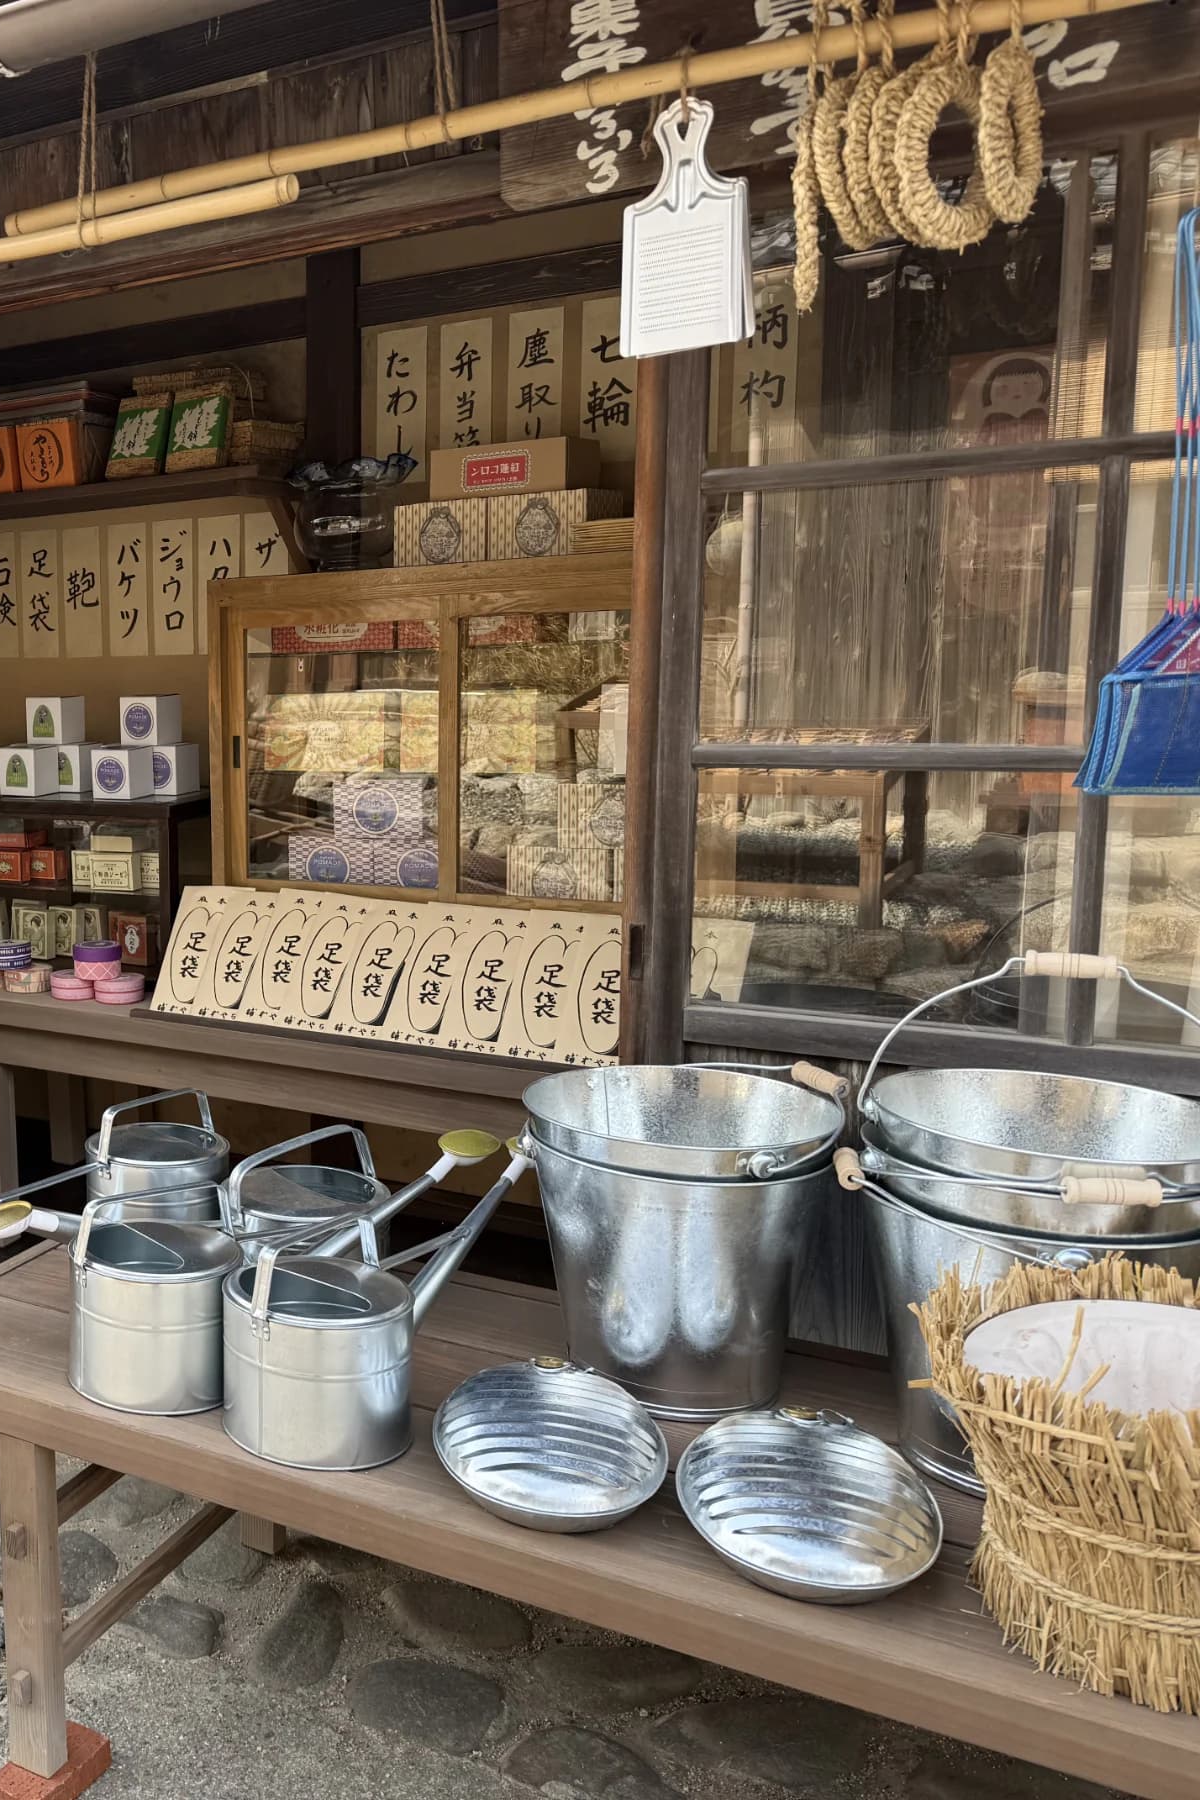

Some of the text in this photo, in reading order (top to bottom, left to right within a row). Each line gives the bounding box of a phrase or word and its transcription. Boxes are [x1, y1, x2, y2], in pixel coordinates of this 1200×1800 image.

[515, 327, 560, 440] 塵取り
[582, 334, 633, 434] 七輪
[27, 549, 56, 632] 足袋
[65, 567, 100, 611] 鞄
[117, 538, 142, 639] バケツ
[159, 529, 188, 631] ジョウロ
[178, 931, 209, 979] 足袋
[223, 935, 253, 984] 足袋
[271, 935, 303, 984] 足袋
[311, 942, 344, 993] 足袋
[360, 947, 395, 998] 足袋
[416, 954, 452, 1006] 足袋
[473, 958, 508, 1013] 足袋
[533, 963, 568, 1019] 足袋
[591, 969, 622, 1025] 足袋
